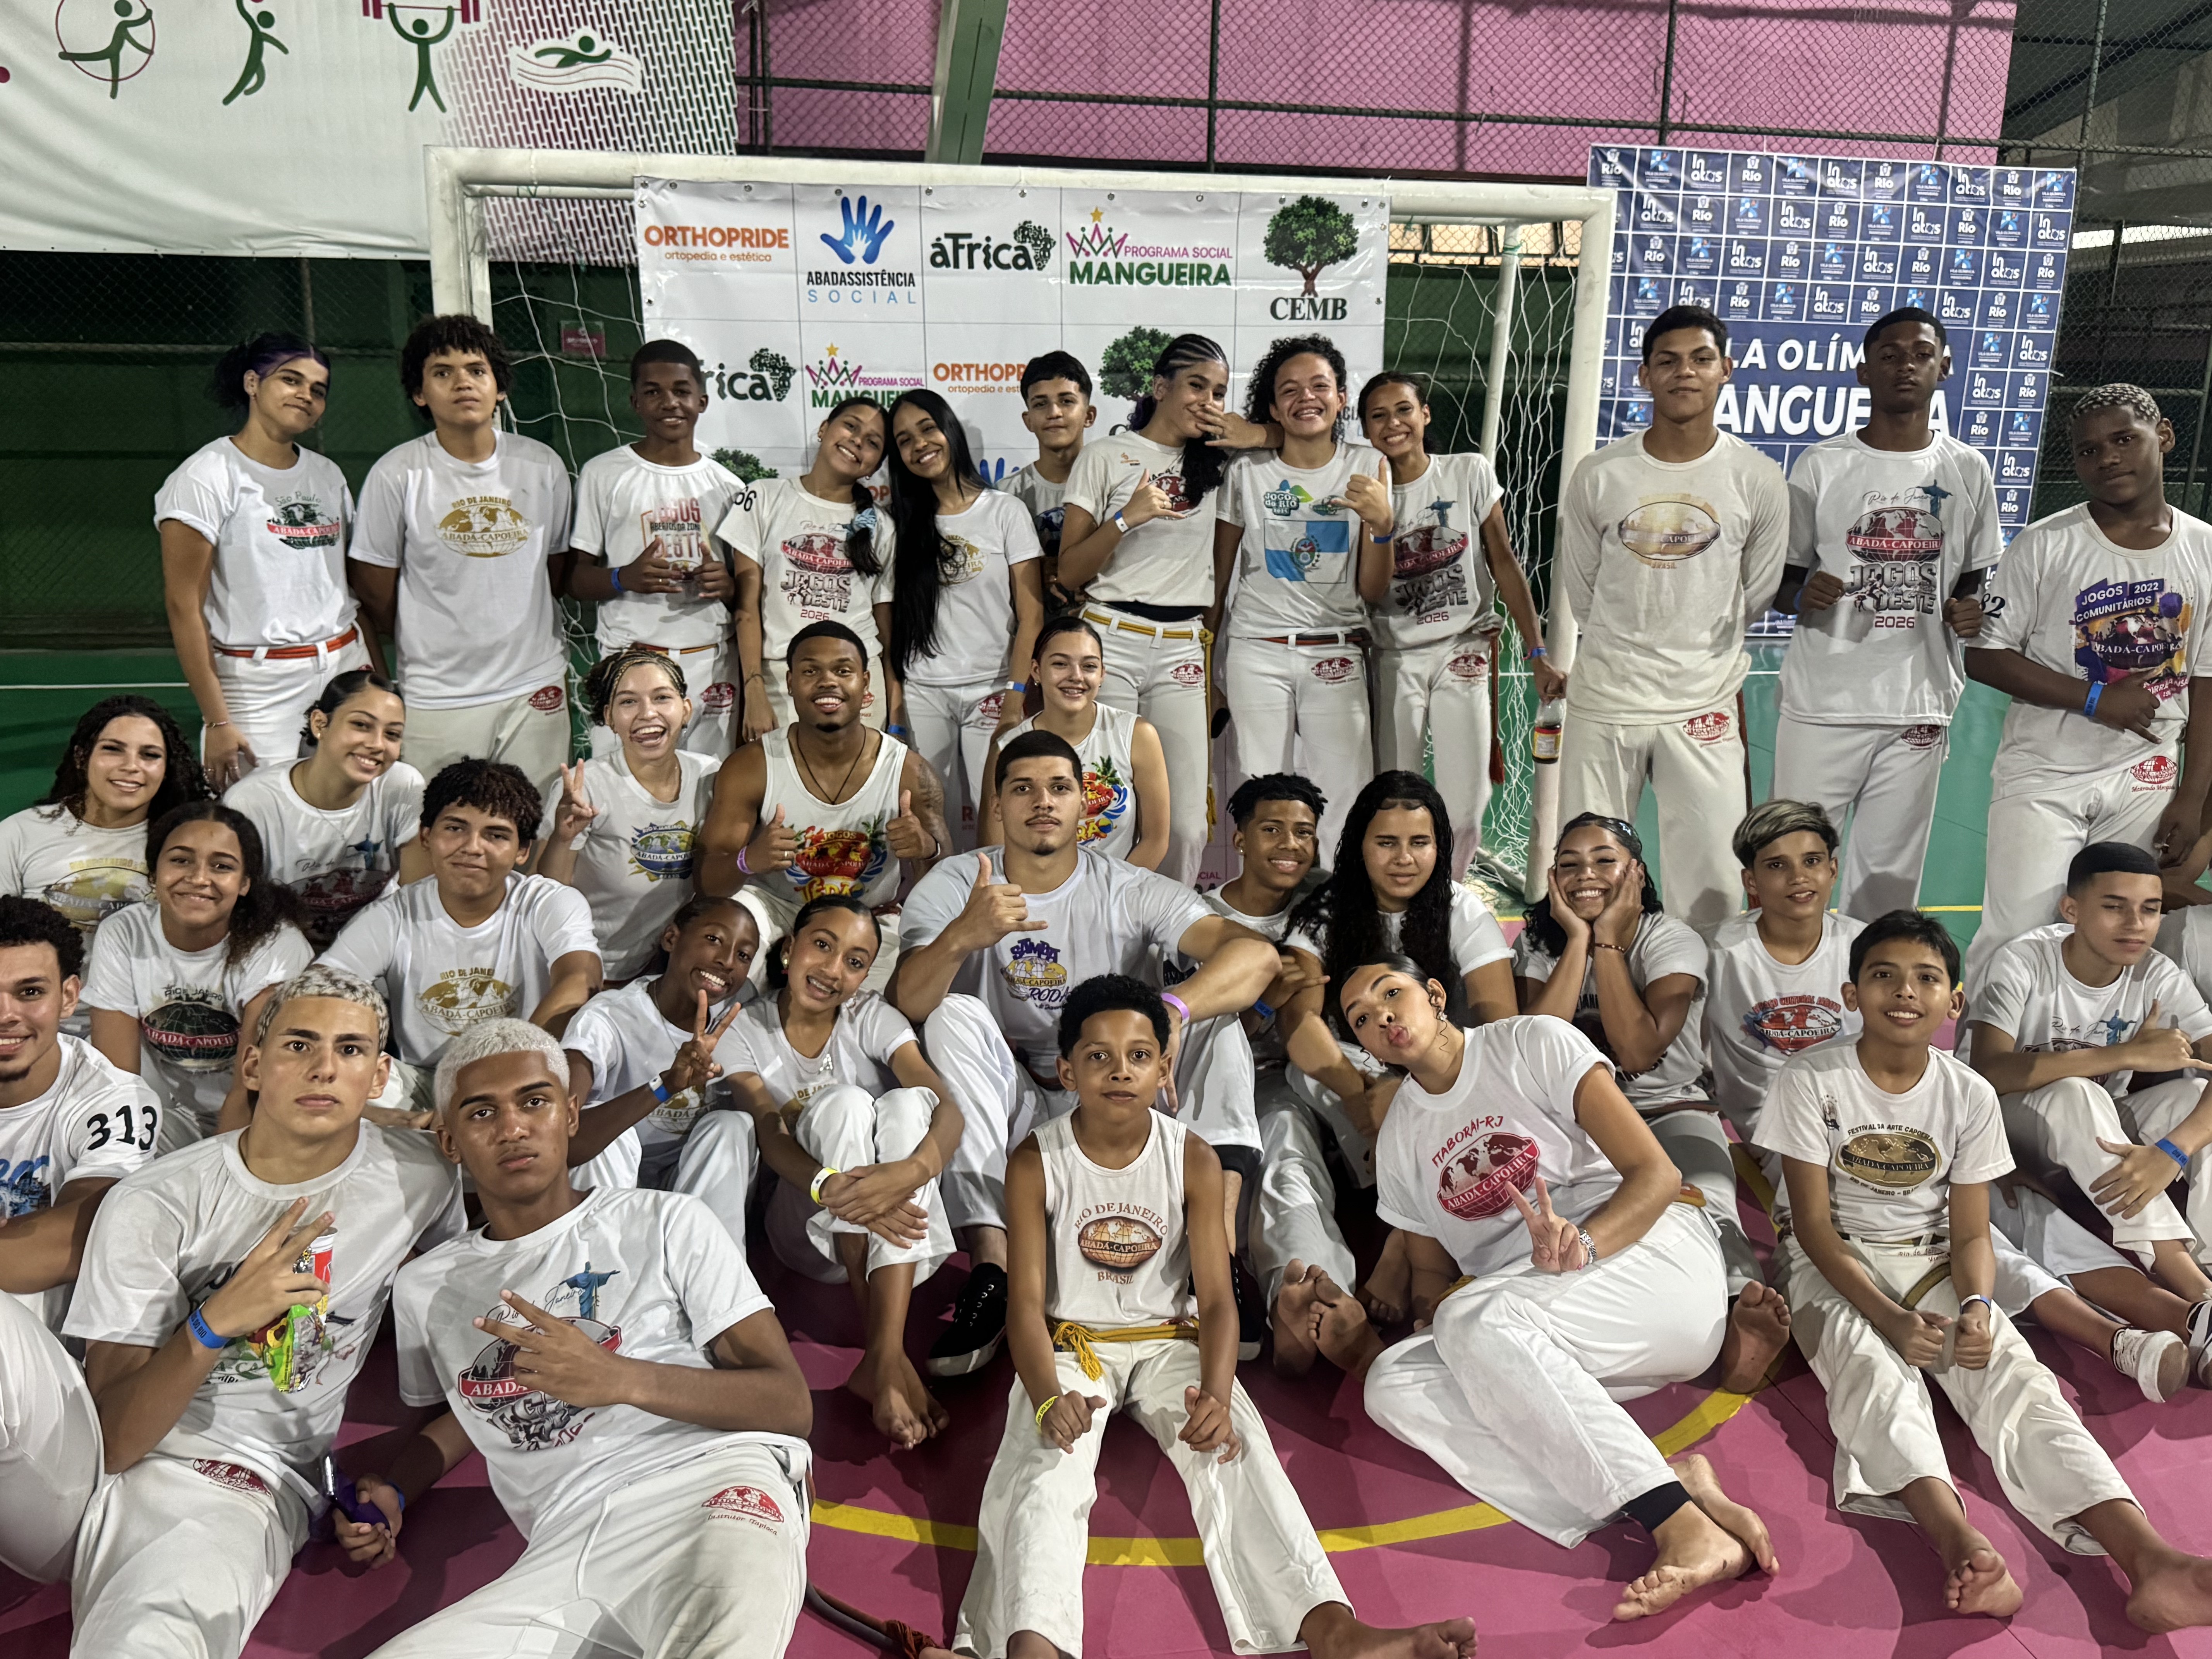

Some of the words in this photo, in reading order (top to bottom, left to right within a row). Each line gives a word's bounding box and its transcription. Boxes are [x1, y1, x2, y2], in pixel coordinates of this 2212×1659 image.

[1601, 163, 1623, 174] Rio
[1742, 170, 1762, 182] Rio
[1875, 177, 1894, 189] Rio
[2004, 185, 2021, 196] Rio
[1692, 210, 1712, 221] Rio
[1829, 215, 1848, 227] Rio
[1958, 222, 1976, 233] Rio
[644, 226, 789, 248] ORTHOPRIDE
[665, 251, 717, 263] ortopedia
[729, 252, 772, 263] estética
[1125, 246, 1189, 258] PROGRAMA
[1192, 246, 1233, 259] SOCIAL
[1644, 251, 1665, 262] Rio
[1781, 256, 1800, 267] Rio
[1911, 261, 1931, 273] Rio
[807, 270, 915, 287] ABADASSISTÊNCIA
[1070, 261, 1231, 286] MANGUEIRA
[2037, 267, 2055, 278] Rio
[808, 290, 916, 304] SOCIAL
[1730, 297, 1750, 307] Rio
[1269, 297, 1348, 321] CEMB
[1861, 301, 1880, 313] Rio
[1989, 306, 2006, 318] Rio
[933, 363, 1027, 382] ORTHOPR
[859, 377, 898, 387] PROGRAMA
[899, 377, 924, 387] SOCIAL
[948, 385, 995, 394] ortopedia
[2019, 387, 2036, 397] Rio
[1971, 424, 1989, 435] Rio
[275, 496, 292, 507] São
[295, 491, 322, 503] Paulo
[452, 499, 465, 508] RIO
[479, 496, 512, 506] JANEIRO
[1265, 493, 1297, 501] JOGOS
[1863, 491, 1887, 505] Rio
[1891, 493, 1900, 504] de
[2001, 502, 2018, 513] Rio
[781, 570, 851, 594] JOGOS
[1845, 562, 1937, 594] JOGOS
[2081, 586, 2123, 605] JOGOS
[2134, 582, 2159, 594] 2022
[1874, 591, 1936, 615] OESTE
[2076, 596, 2152, 622] COMUNITÁRIOS
[800, 610, 830, 620] 2026
[1417, 611, 1449, 625] 2026
[1875, 616, 1915, 628] 2026
[824, 831, 857, 841] JOGOS
[1010, 938, 1061, 963] SAMBA
[440, 970, 456, 980] RIO
[458, 969, 467, 977] DE
[1029, 986, 1071, 1002] RODA
[797, 1089, 810, 1099] DE
[87, 1105, 157, 1150] 313
[1848, 1124, 1876, 1136] FESTIVAL
[1074, 1208, 1092, 1229] RIO
[1095, 1203, 1116, 1214] DE
[1116, 1202, 1168, 1235] JANEIRO
[1097, 1271, 1134, 1285] BRASIL
[197, 1326, 208, 1338] RIO
[749, 1519, 778, 1535] Tapioca
